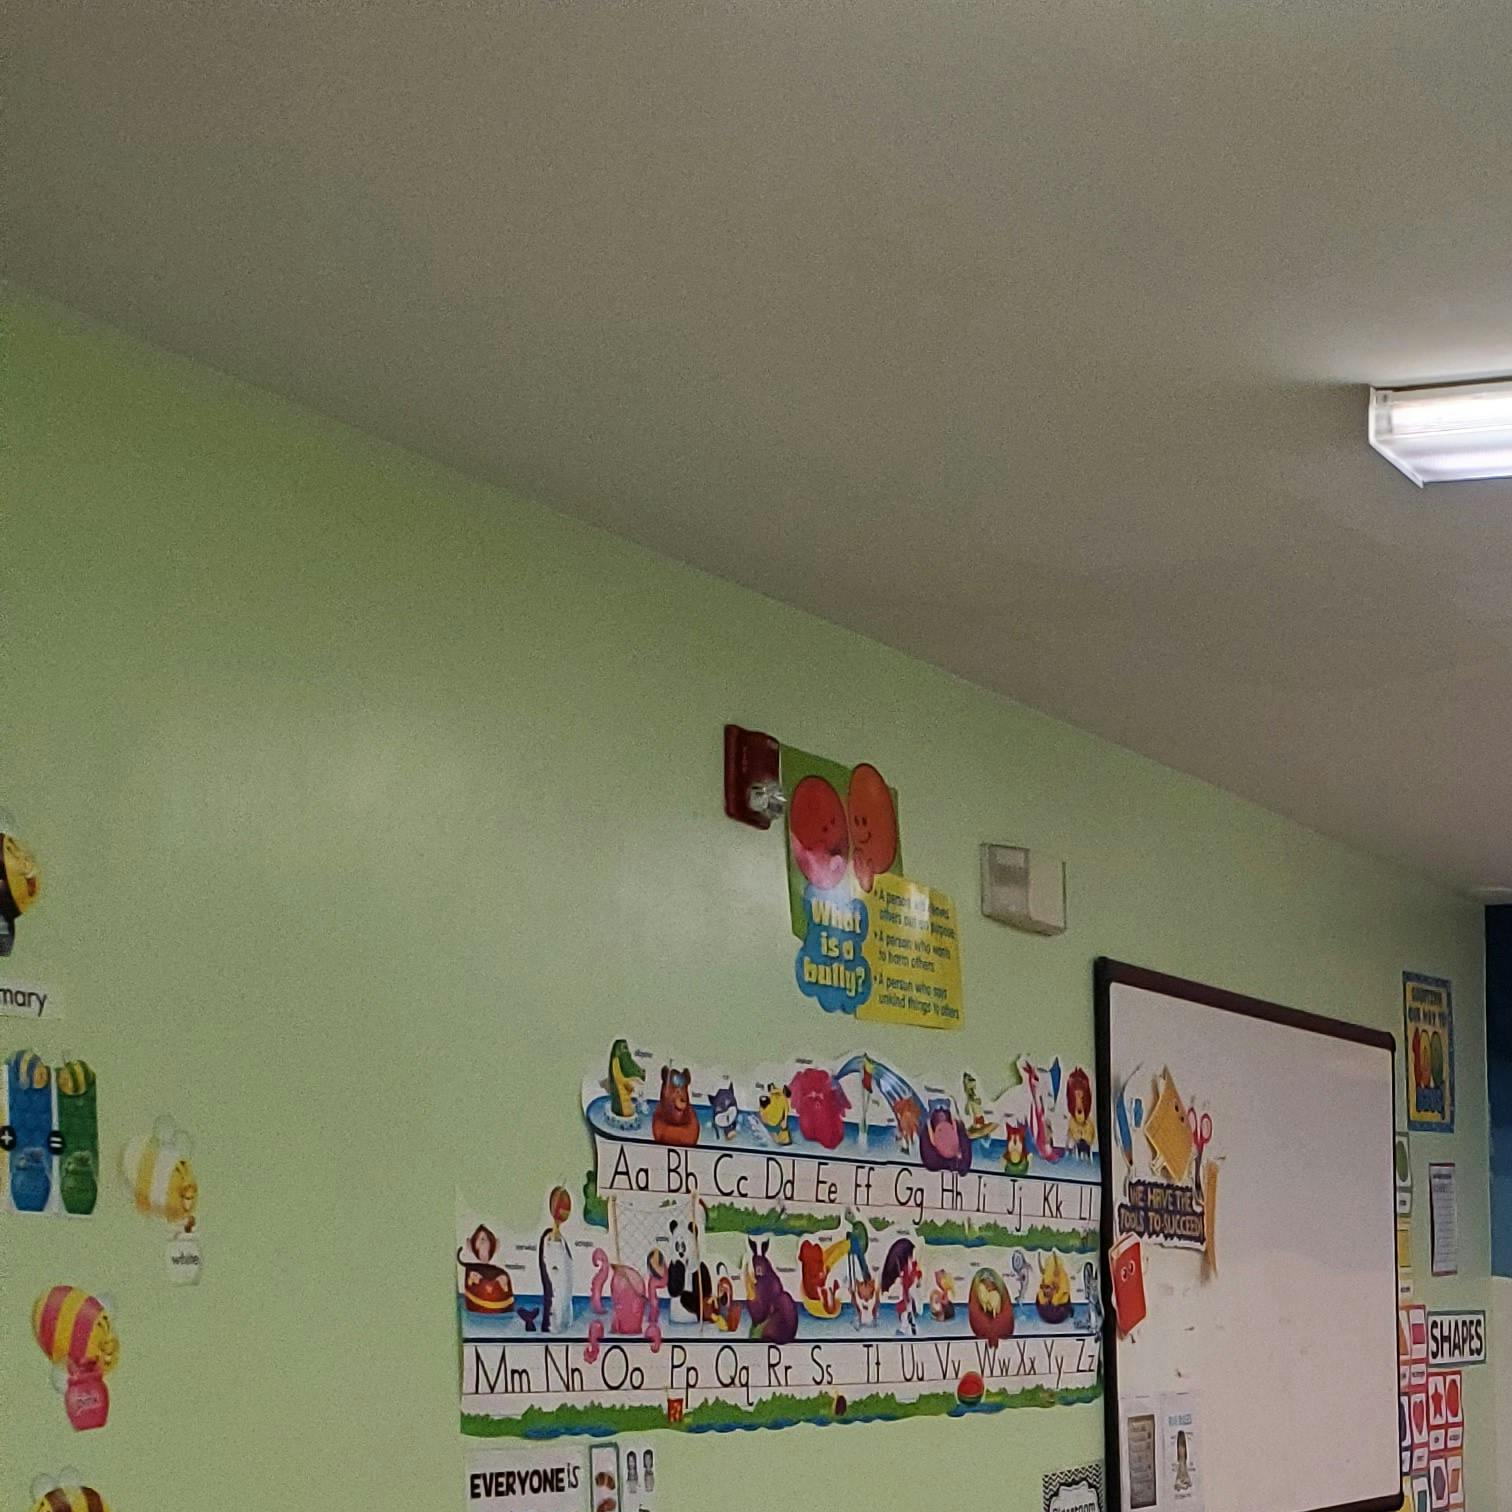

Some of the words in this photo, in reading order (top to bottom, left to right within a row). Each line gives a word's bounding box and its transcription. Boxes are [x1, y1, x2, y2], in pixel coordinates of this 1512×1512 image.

[811, 898, 862, 933] What
[820, 931, 840, 957] is
[842, 940, 854, 960] a
[803, 956, 866, 997] bully?
[609, 1144, 650, 1192] Aa
[713, 1153, 749, 1198] Cc
[766, 1157, 796, 1200] Dd
[816, 1161, 838, 1204] Ee
[854, 1166, 875, 1206] Ff
[895, 1168, 924, 1226] Gg
[940, 1171, 964, 1211] Hh
[977, 1175, 987, 1213] Ii
[1006, 1179, 1023, 1233] Jj
[1042, 1183, 1063, 1219] Kk
[1079, 1186, 1093, 1221] Ll
[1148, 1187, 1173, 1210] HAVE
[1174, 1191, 1192, 1212] THE
[1120, 1208, 1145, 1233] TOOLS
[1148, 1212, 1160, 1233] TO
[1430, 1319, 1483, 1360] SHAPES
[474, 1345, 531, 1394] Mm
[545, 1344, 584, 1393] Nn
[602, 1344, 645, 1390] Oo
[670, 1344, 699, 1409] Pp
[715, 1345, 754, 1406] Qq
[767, 1345, 792, 1387] Rr
[810, 1344, 834, 1386] Ss
[863, 1344, 880, 1384] Tt
[900, 1344, 925, 1383] Uu
[934, 1342, 961, 1381] Vv
[975, 1340, 1011, 1378] Ww
[1016, 1340, 1037, 1376] Xx
[1043, 1339, 1064, 1389] Yy
[1076, 1339, 1095, 1373] Zz
[470, 1467, 565, 1499] EVERYONE
